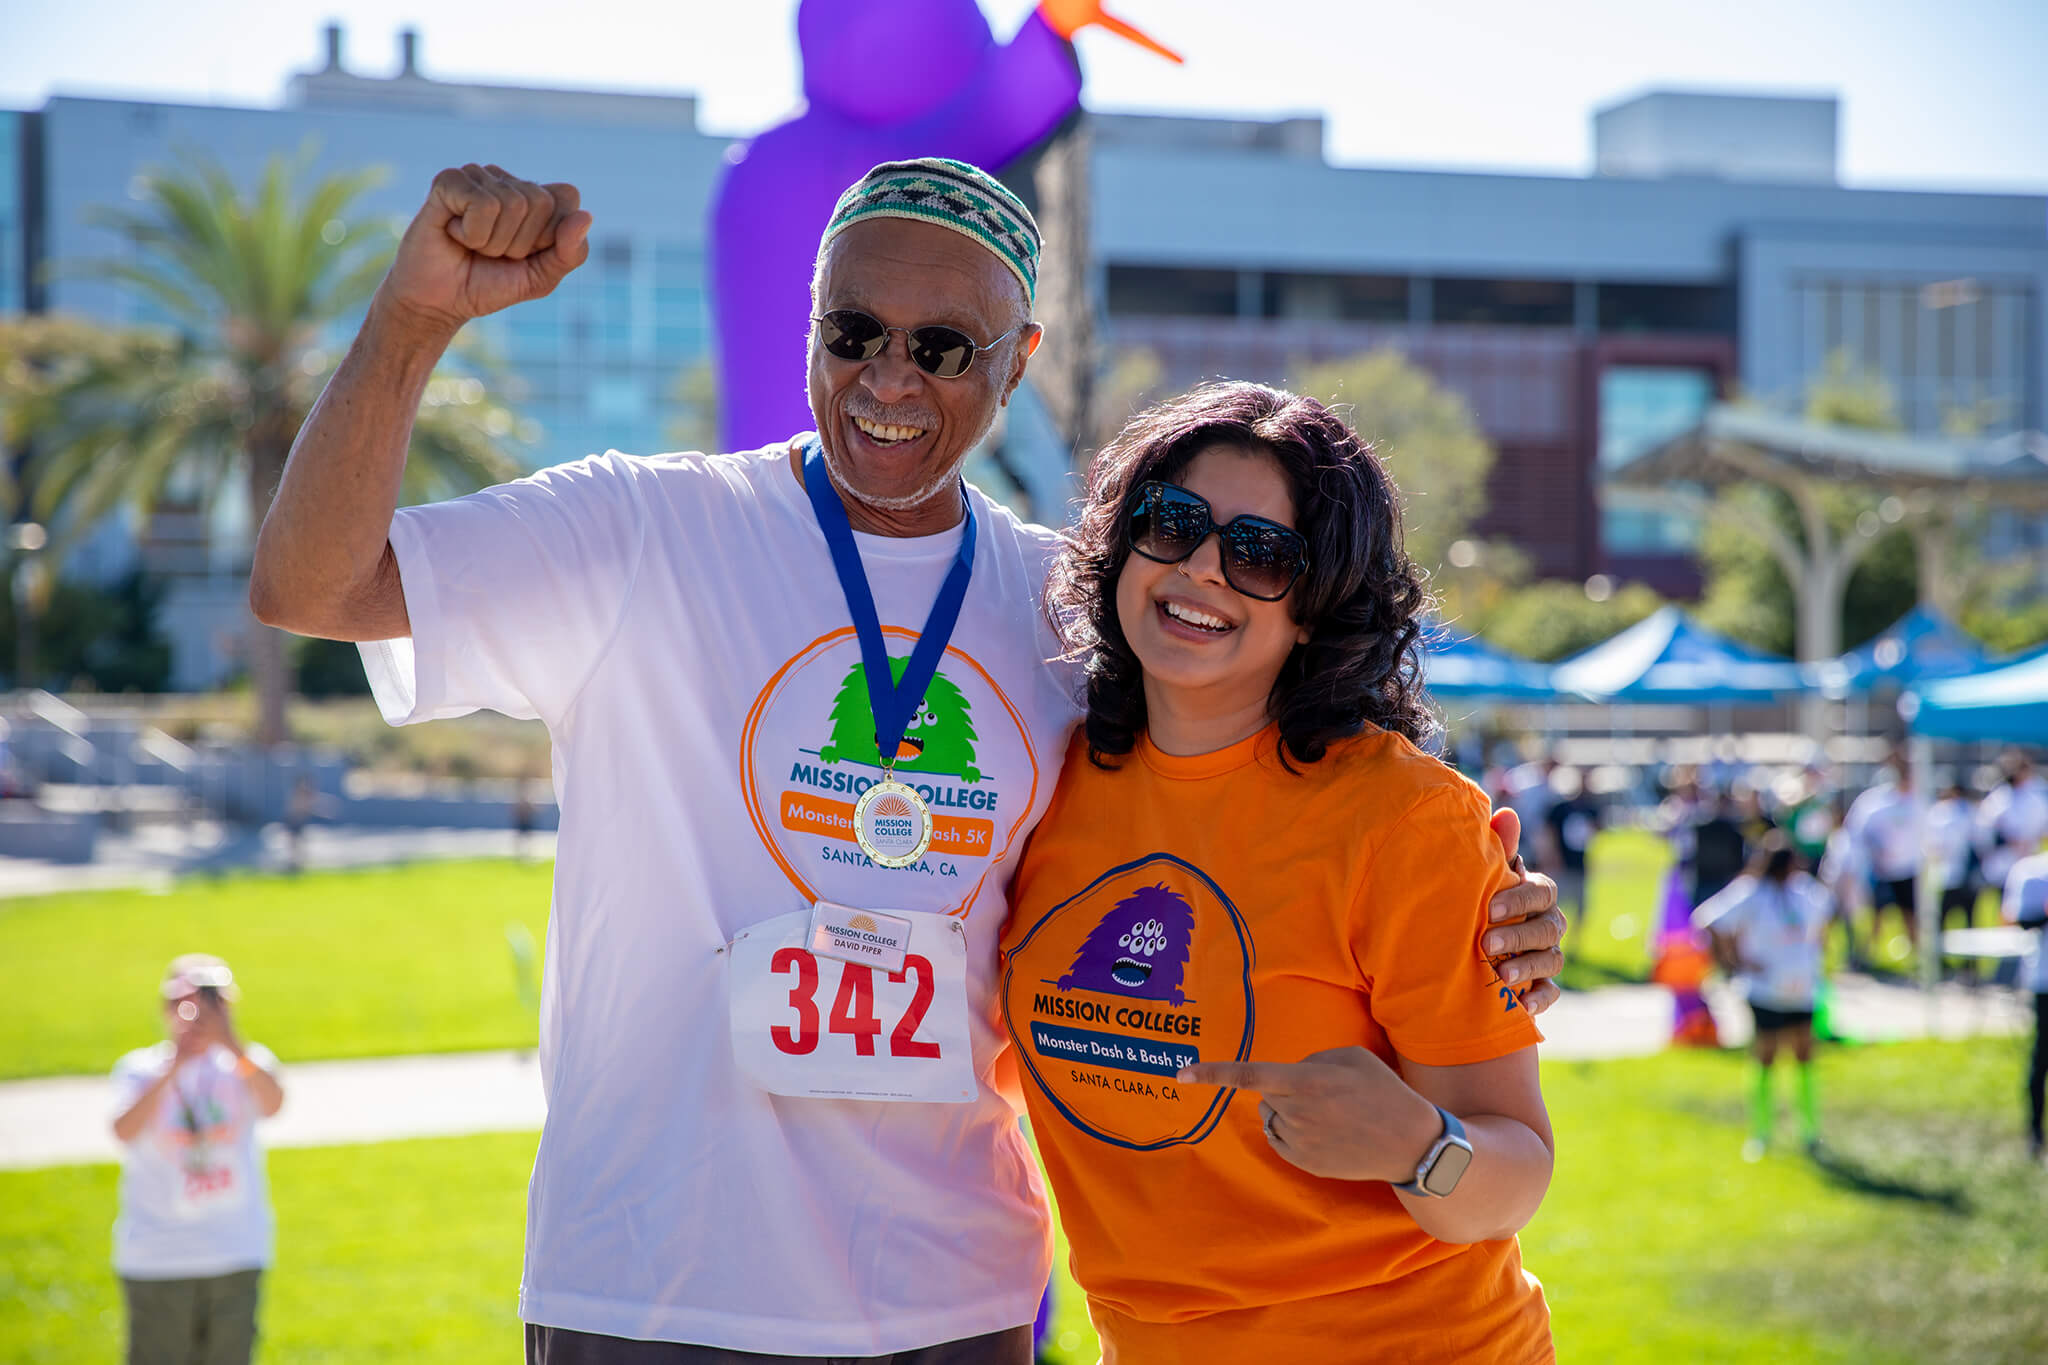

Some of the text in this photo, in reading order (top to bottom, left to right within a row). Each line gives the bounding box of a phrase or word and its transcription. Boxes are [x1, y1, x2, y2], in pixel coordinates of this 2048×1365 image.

[790, 762, 881, 796] MISSIO
[875, 819, 912, 827] MISSION
[875, 828, 912, 836] COLLEGE
[933, 827, 961, 843] ash
[965, 830, 986, 844] 5K
[822, 846, 873, 868] SANTA
[940, 862, 958, 877] CA
[824, 925, 897, 947] MISSION COLLEGE
[834, 939, 882, 956] DAVID PIPER
[770, 947, 941, 1059] 342
[1033, 994, 1201, 1036] MISSION COLLEGE
[1038, 1033, 1193, 1069] Monster Dash & Bash 5K
[1071, 1070, 1180, 1101] SANTA CLARA, CA
